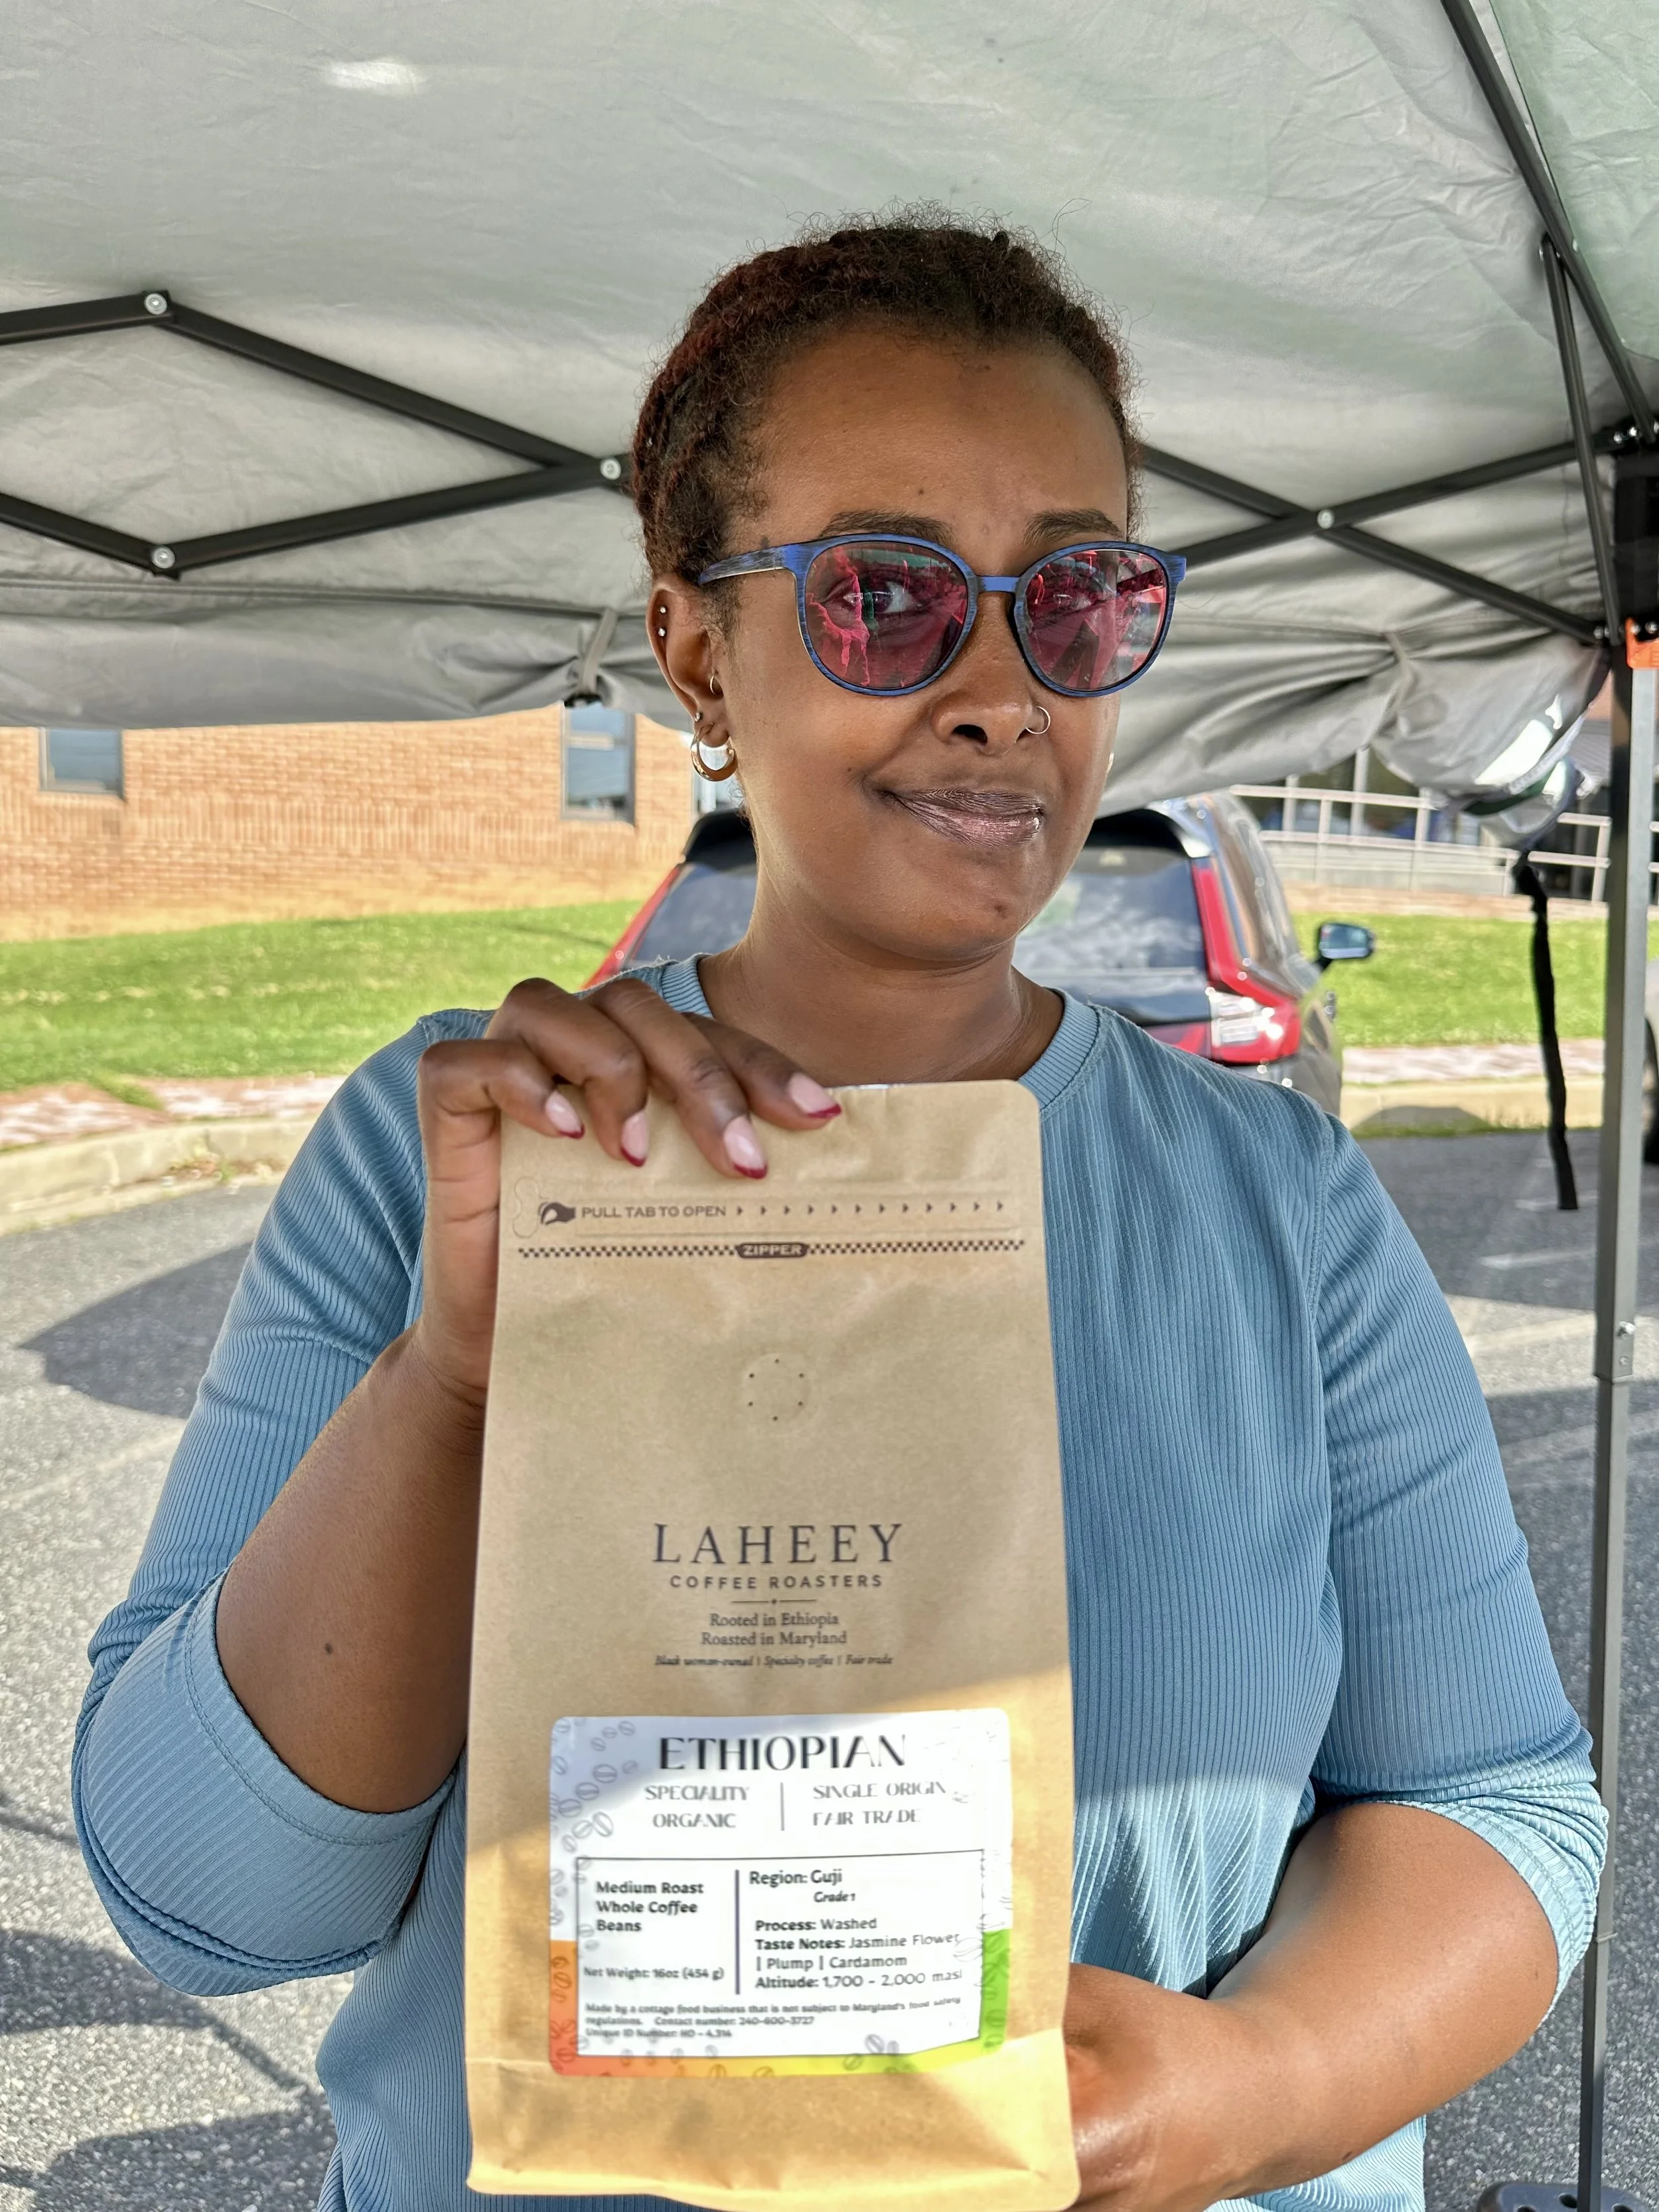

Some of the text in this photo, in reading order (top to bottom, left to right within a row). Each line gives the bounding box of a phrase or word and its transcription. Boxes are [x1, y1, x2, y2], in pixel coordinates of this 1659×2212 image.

[581, 1205, 726, 1218] PULL TAB TO OPEN
[743, 1244, 802, 1256] ZIPPER
[652, 1523, 902, 1564] LAHEEY
[670, 1575, 883, 1589] COFFEE ROASTERS
[709, 1613, 839, 1629] Rooted in Ethiopia
[701, 1631, 847, 1649] Roasted in Maryland
[660, 1734, 905, 1771] ETHIOPIAN
[813, 1781, 946, 1799] SINGLE ORIGIN
[652, 1813, 737, 1828] ORGANIC
[749, 1868, 843, 1888] Region: Guji
[597, 1881, 704, 1893] Medium Roast
[814, 1891, 848, 1902] Grade
[597, 1900, 698, 1915] Whole Coffee
[597, 1919, 642, 1931] Beans
[755, 1917, 877, 1931] Process: Washed
[755, 1933, 960, 1950] Taste Notes: Jasmine Flower
[766, 1957, 814, 1972] Plump
[829, 1956, 908, 1968] Cardamom
[584, 1966, 725, 1980] Net Weight: 16oz (454 g)
[755, 1976, 819, 1988] Altitude:
[932, 1969, 962, 1982] masl
[586, 2004, 612, 2013] Made
[615, 2004, 627, 2014] by
[639, 2005, 674, 2014] cottage
[678, 2004, 700, 2014] food
[703, 2004, 746, 2013] business
[749, 2004, 768, 2013] that
[771, 2004, 779, 2013] is
[782, 2004, 799, 2013] not
[802, 2004, 837, 2013] subject
[853, 2002, 905, 2013] Maryland's
[586, 2016, 815, 2026] regulations. Contact number: 240-600-3727
[586, 2029, 620, 2039] Unique
